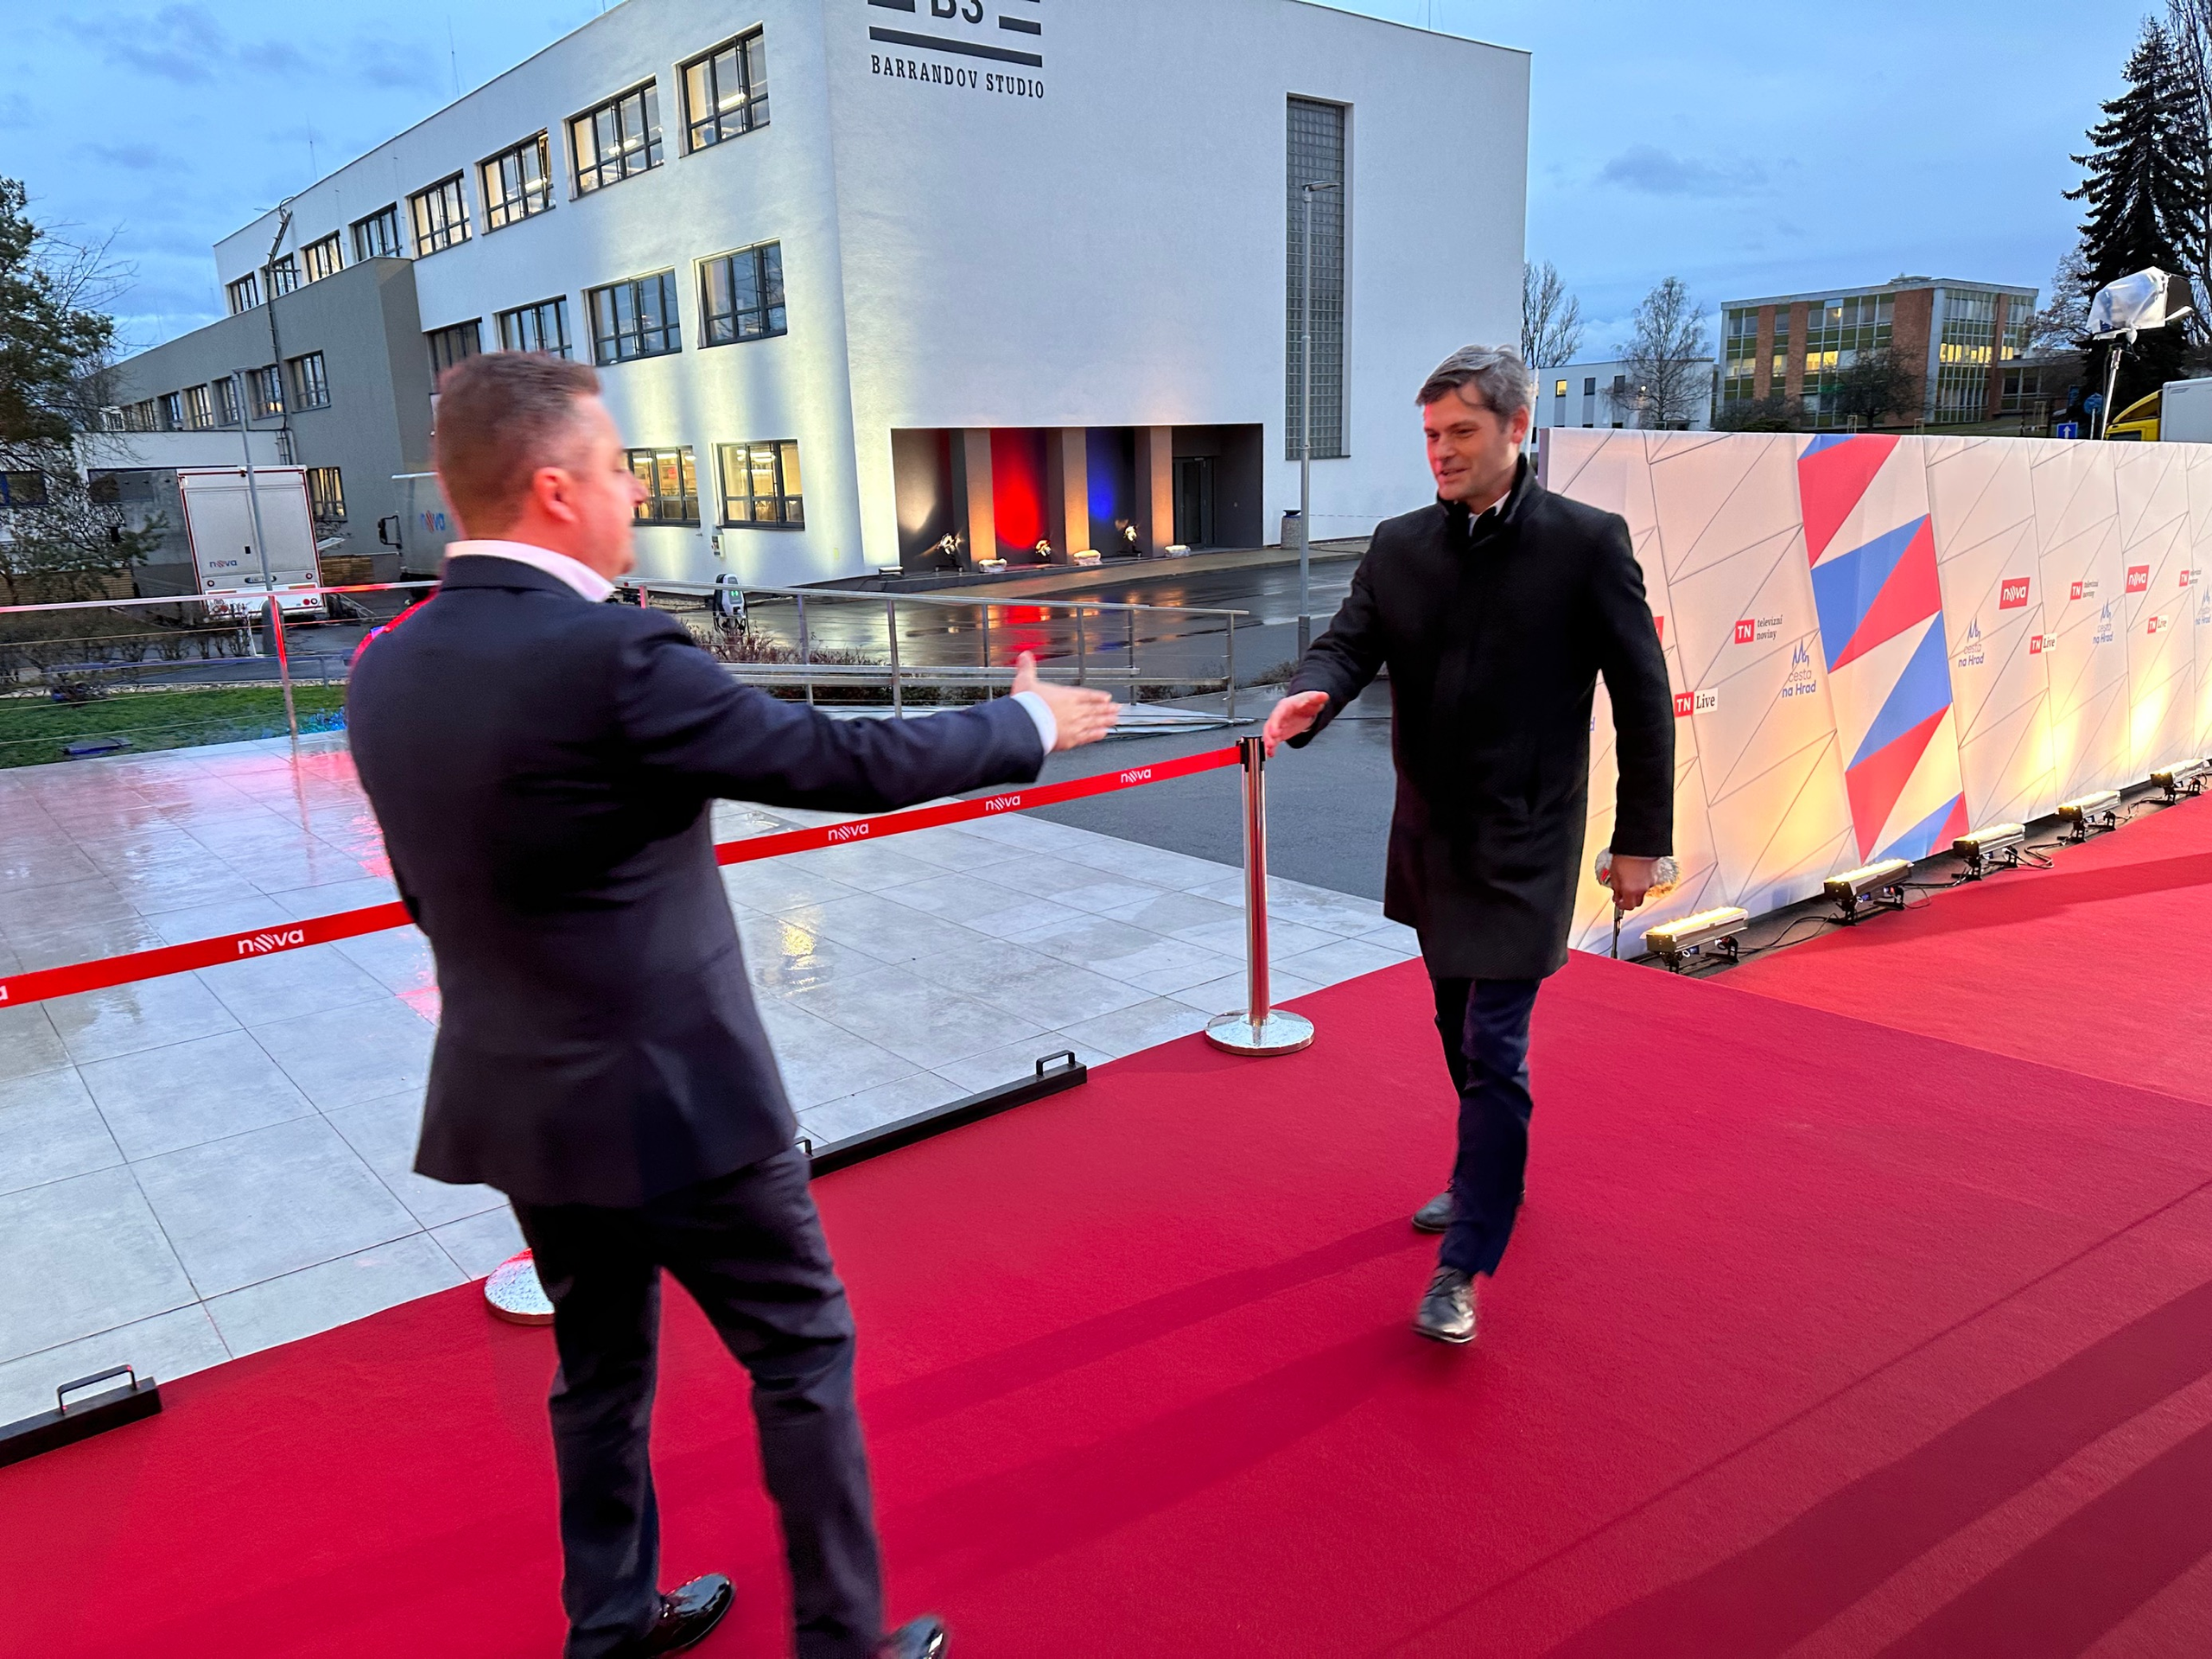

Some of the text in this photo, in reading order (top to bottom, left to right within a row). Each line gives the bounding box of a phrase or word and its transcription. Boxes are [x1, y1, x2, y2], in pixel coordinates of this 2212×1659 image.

[871, 54, 1044, 99] BARRANDOV STUDIO
[2003, 585, 2027, 602] nova
[2072, 586, 2082, 596] TN
[1757, 614, 1783, 628] televizní
[1737, 624, 1752, 639] TN
[1756, 629, 1777, 641] noviny
[1963, 644, 1982, 655] cesta
[2031, 637, 2056, 651] TN Live
[1958, 652, 1985, 668] na Hrad
[1788, 669, 1812, 683] cesta
[1782, 679, 1816, 698] na Hrad
[1676, 693, 1716, 712] TN Live
[1120, 768, 1152, 783] nova
[985, 795, 1020, 810] nova
[828, 823, 869, 841] nova
[238, 929, 304, 954] nova
